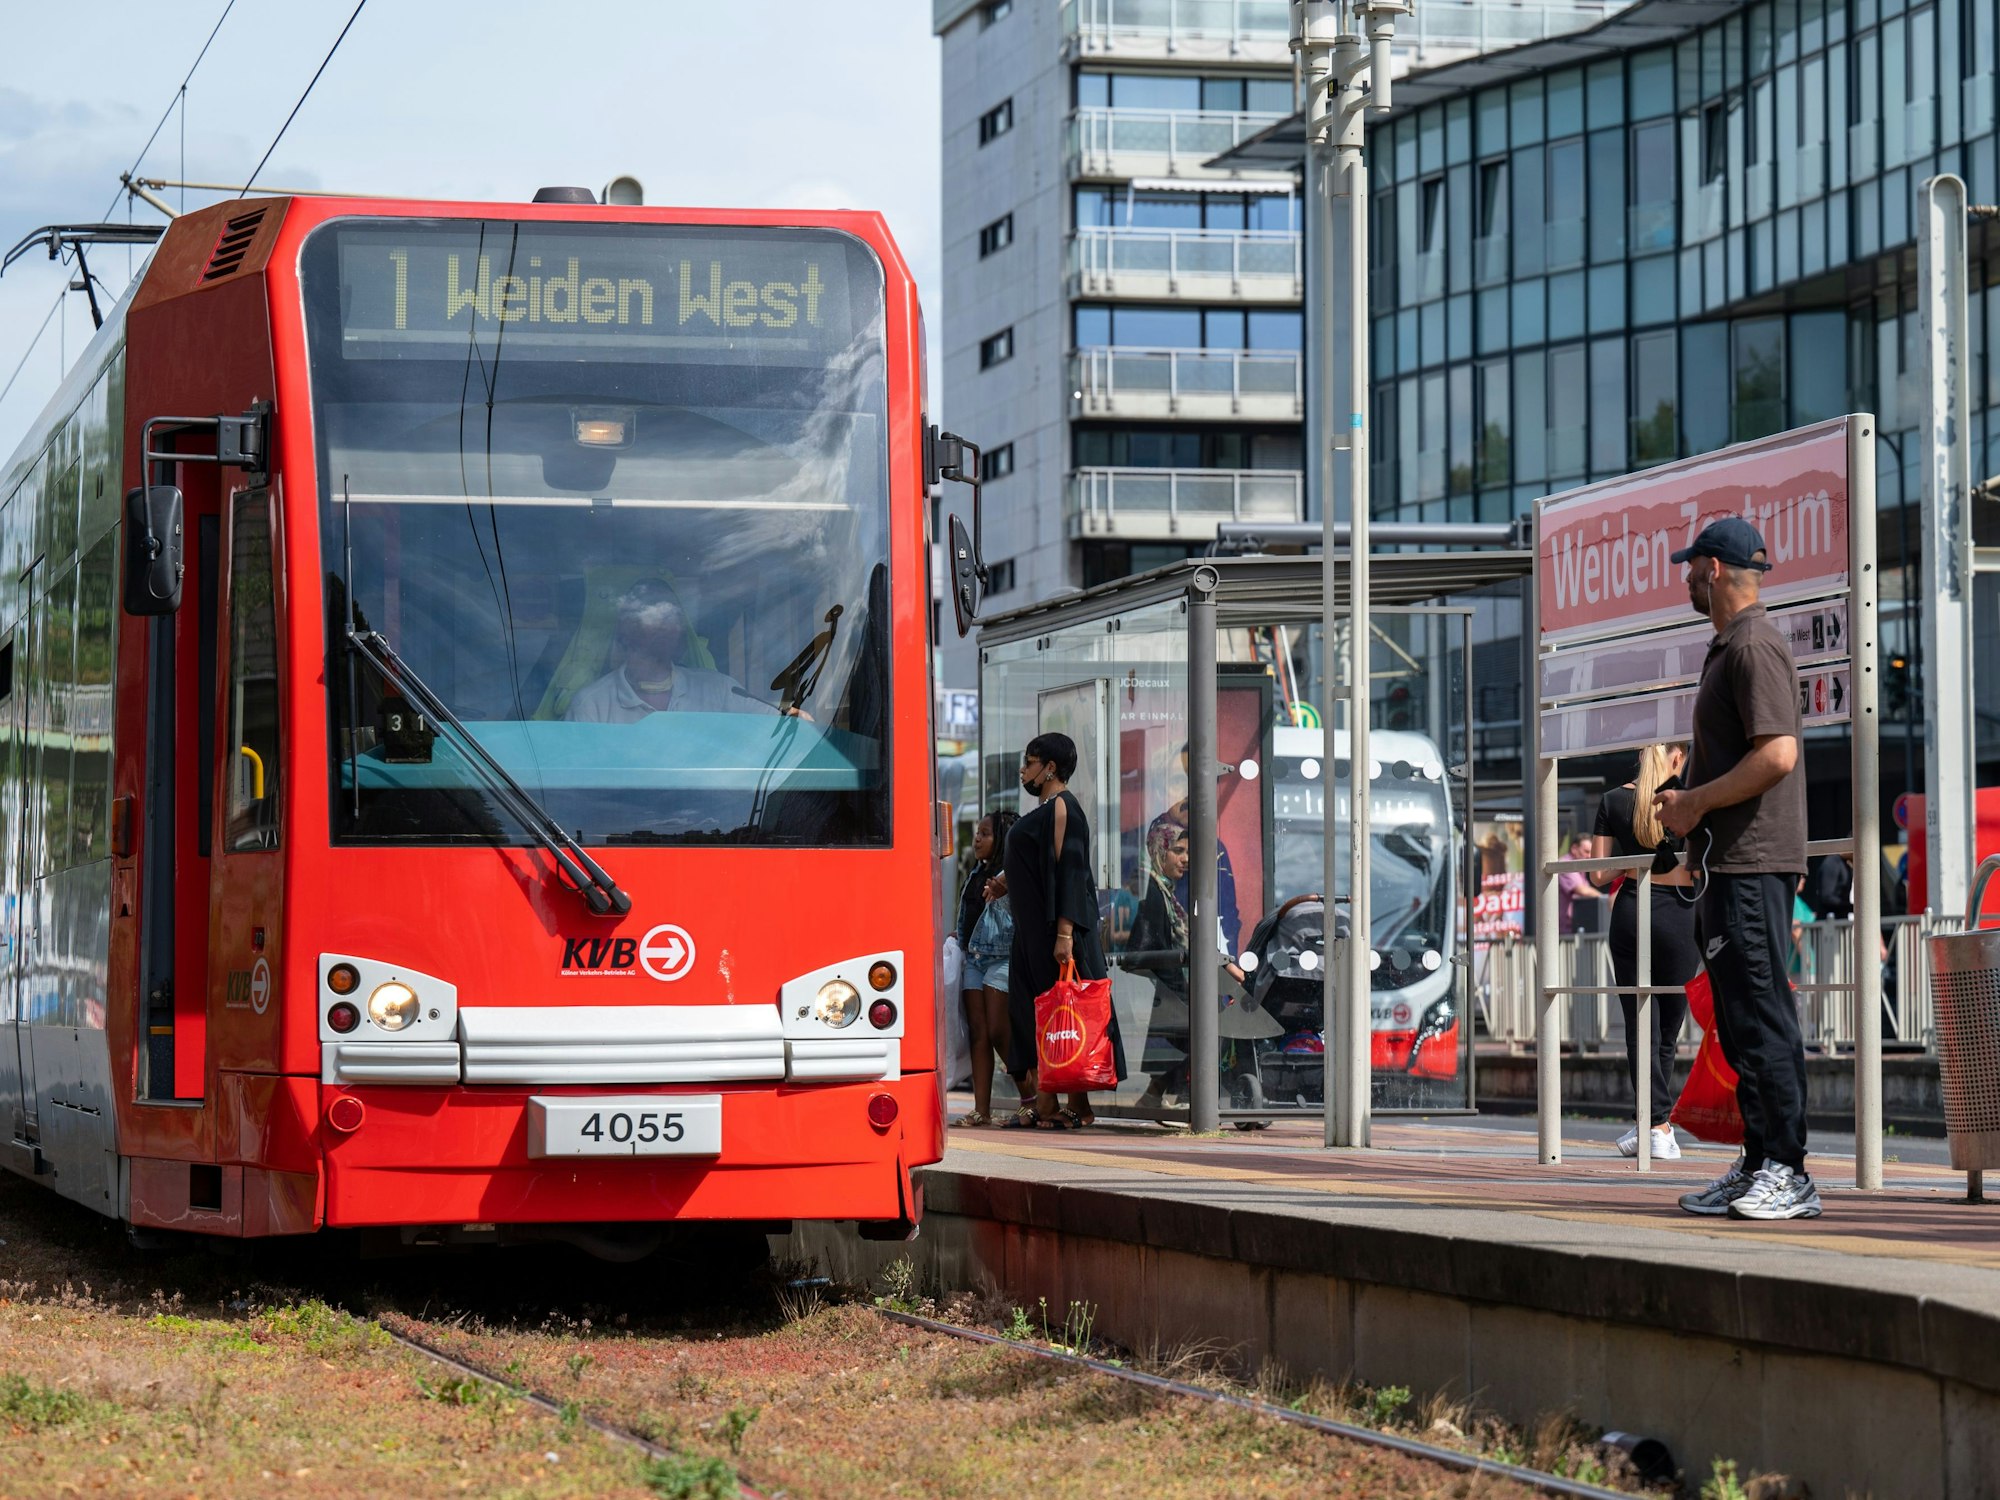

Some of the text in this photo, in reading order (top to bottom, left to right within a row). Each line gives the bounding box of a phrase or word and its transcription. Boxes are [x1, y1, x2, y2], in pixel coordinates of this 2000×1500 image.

[390, 250, 825, 330] 1 Weiden West
[1551, 512, 1670, 610] Weiden
[1119, 677, 1170, 688] JCDecaux
[1139, 711, 1183, 721] EINMAL
[562, 938, 637, 968] KVB
[227, 971, 252, 1002] KVB
[581, 1113, 684, 1142] 4055
